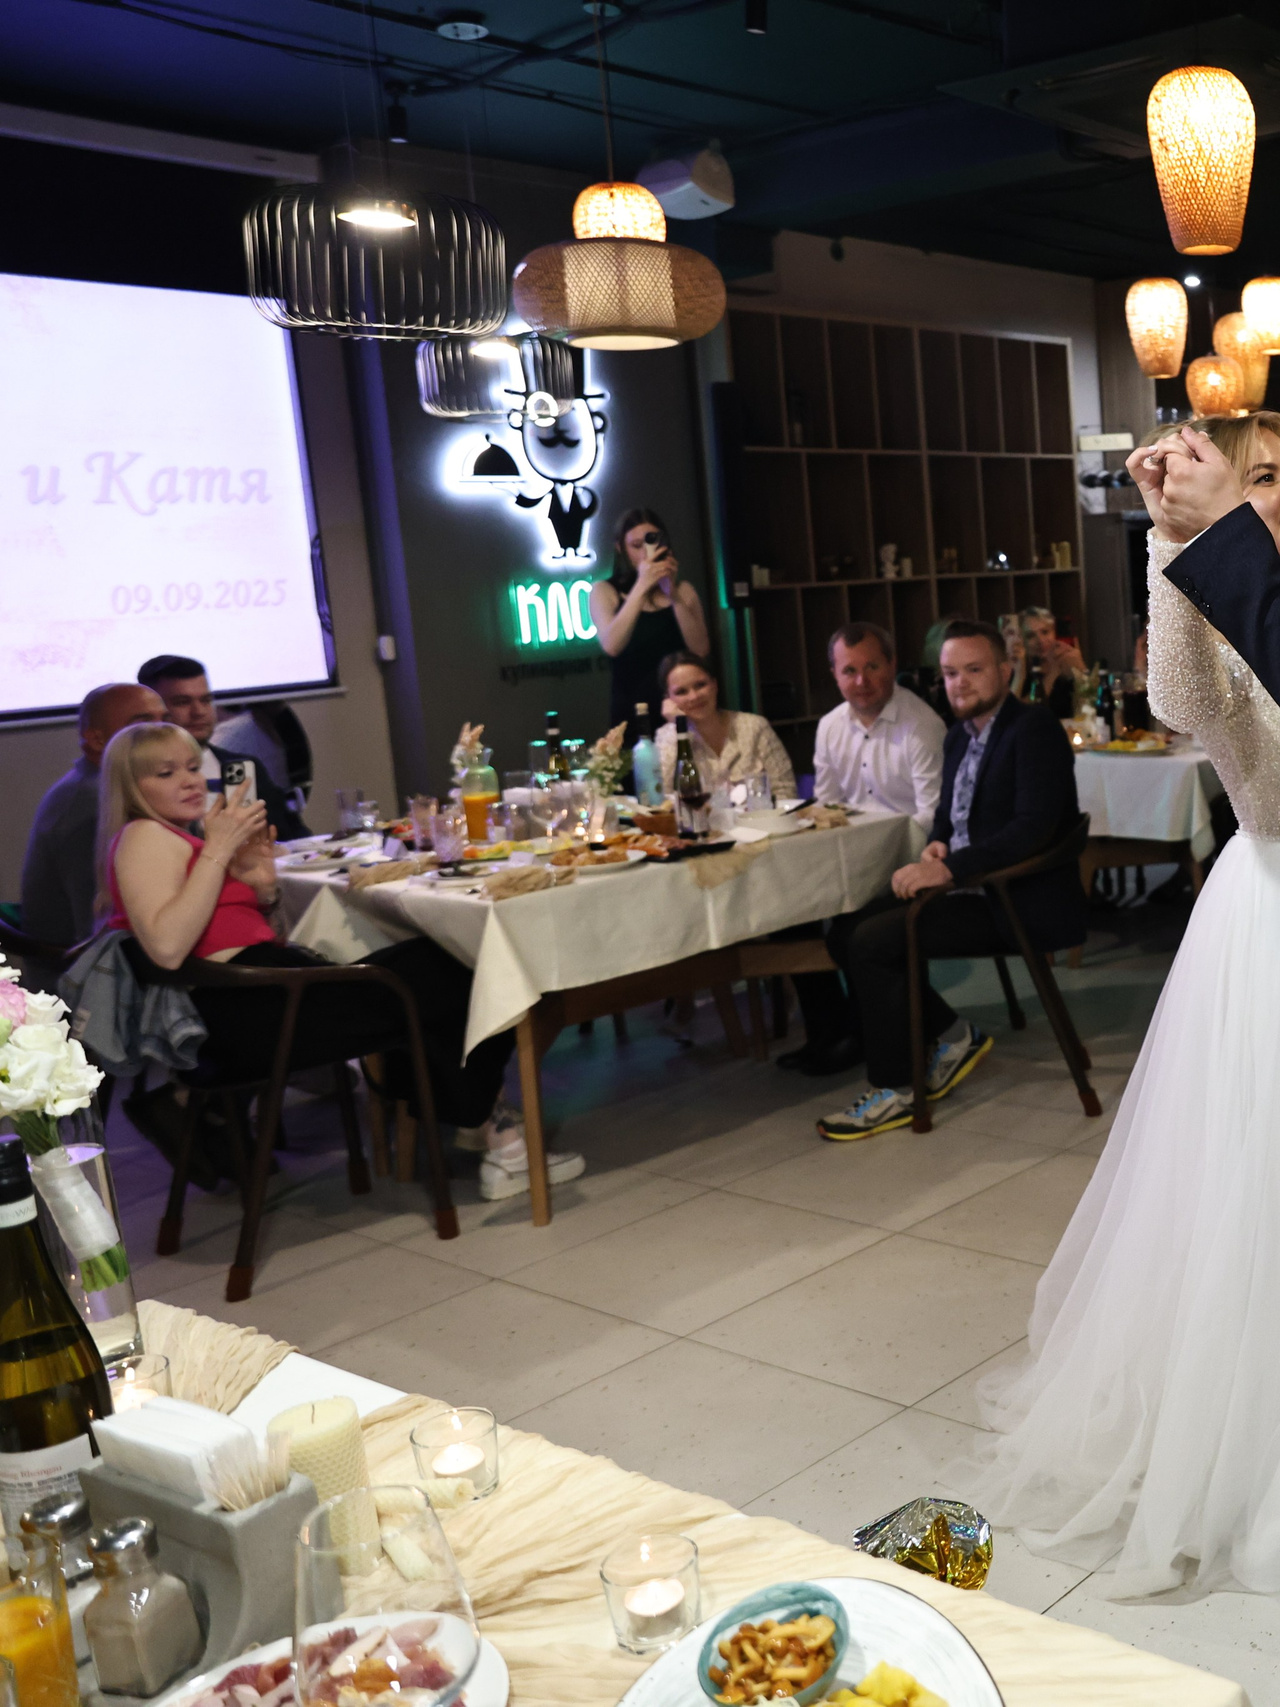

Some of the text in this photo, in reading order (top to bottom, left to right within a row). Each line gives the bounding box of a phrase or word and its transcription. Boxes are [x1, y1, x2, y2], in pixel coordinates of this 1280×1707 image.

[20, 451, 273, 517] и Катя
[110, 577, 287, 616] 09.09.2025
